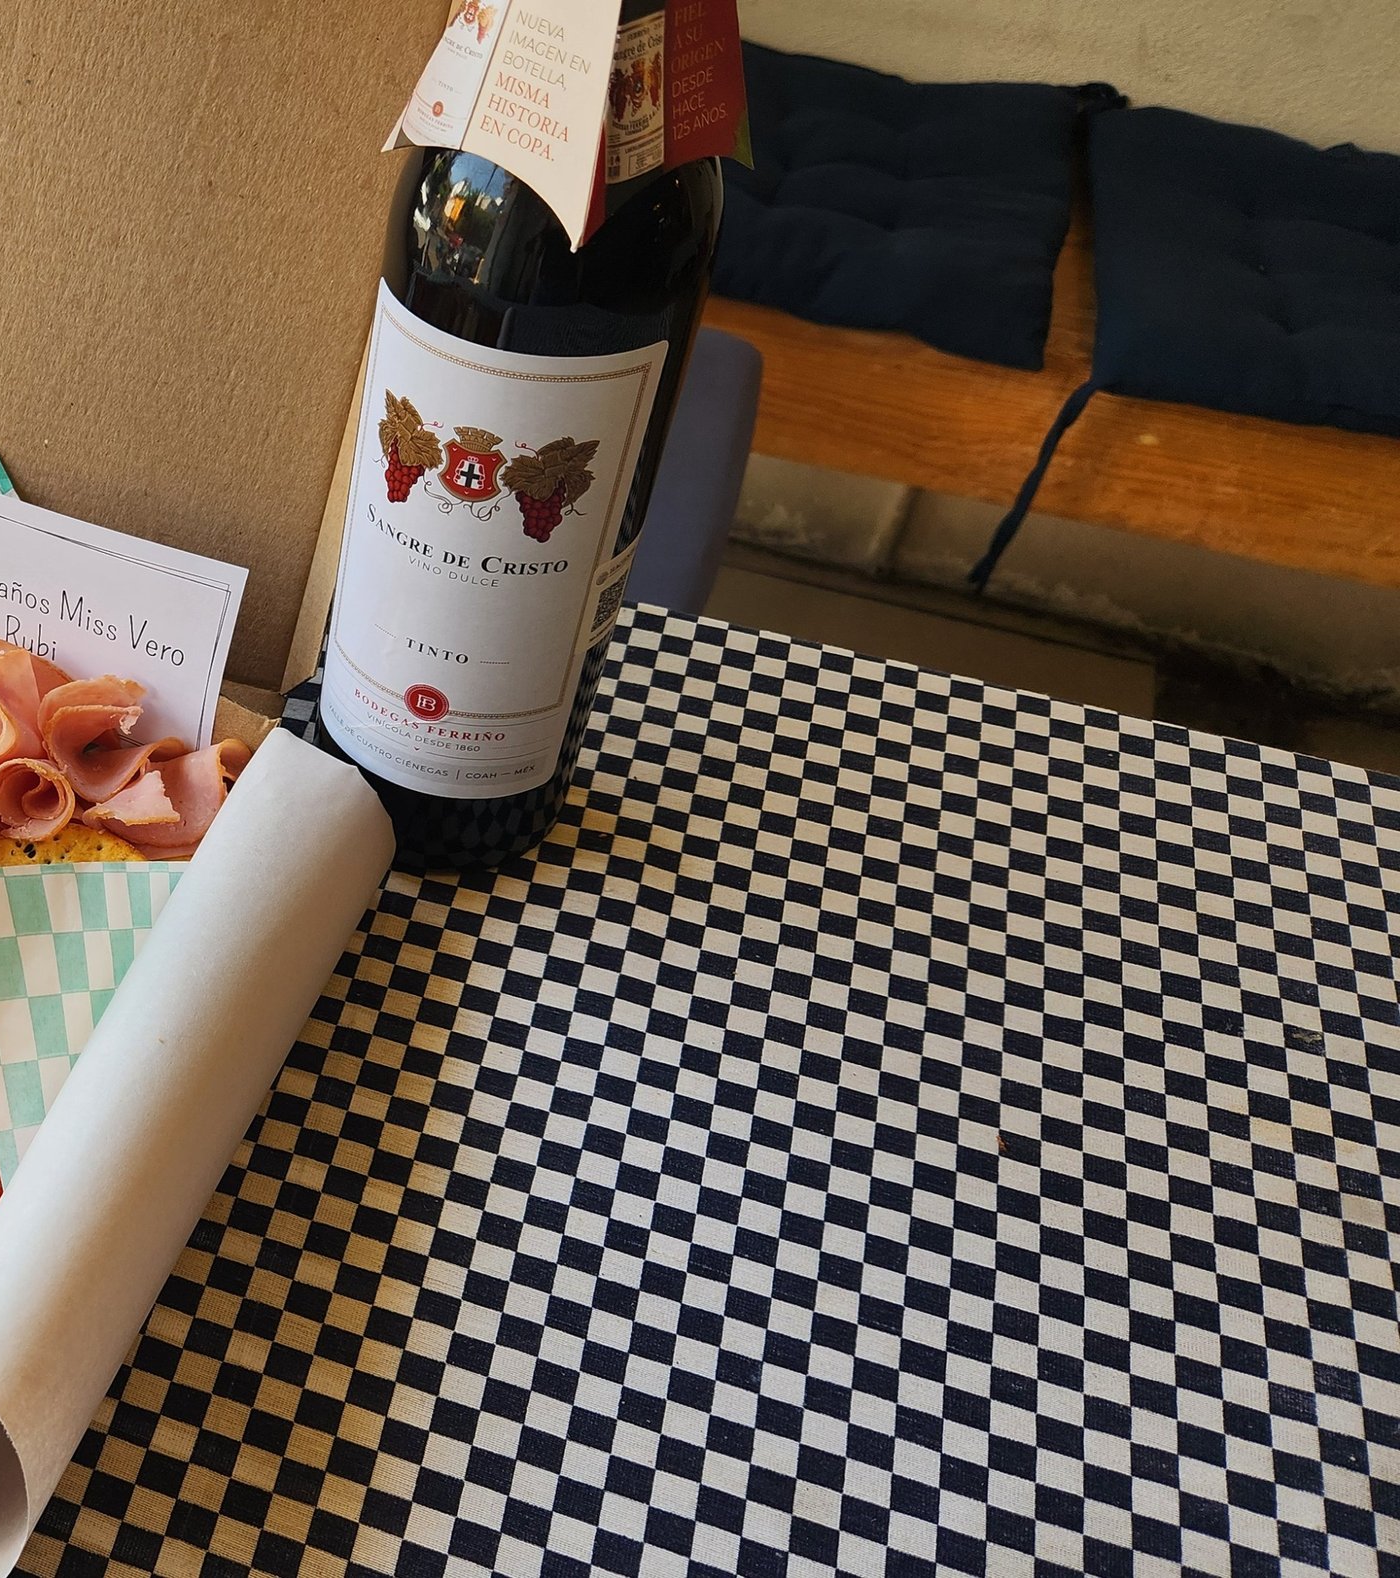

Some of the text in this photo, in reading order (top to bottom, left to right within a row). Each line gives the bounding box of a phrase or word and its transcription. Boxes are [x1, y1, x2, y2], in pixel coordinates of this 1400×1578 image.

[516, 10, 565, 41] NUEVA
[674, 1, 706, 27] FIEL
[509, 30, 592, 74] IMAGEN EN
[637, 39, 646, 52] de
[685, 24, 704, 45] SU
[503, 50, 567, 91] BOTELLA,
[671, 38, 726, 74] ORIGEN
[495, 71, 550, 109] MISMA
[672, 66, 714, 98] DESDE
[487, 93, 569, 142] HISTORIA
[672, 91, 706, 120] HACE
[480, 115, 555, 162] EN COPA.
[672, 121, 691, 140] 125
[366, 503, 569, 576] SANGRE DE CRISTO
[408, 555, 500, 588] VINO DULCE
[6, 615, 57, 662] Rubi
[60, 590, 118, 642] Miss
[129, 614, 185, 667] Vero
[406, 637, 470, 665] TINTO
[354, 688, 506, 742] BODEGAS FERRIÑO
[366, 711, 481, 753] VINÍCOLA DESDE 1860
[344, 725, 356, 738] DE
[356, 735, 393, 760] CUATRO
[395, 756, 449, 777] CIÉNEGAS
[465, 771, 497, 780] COAH
